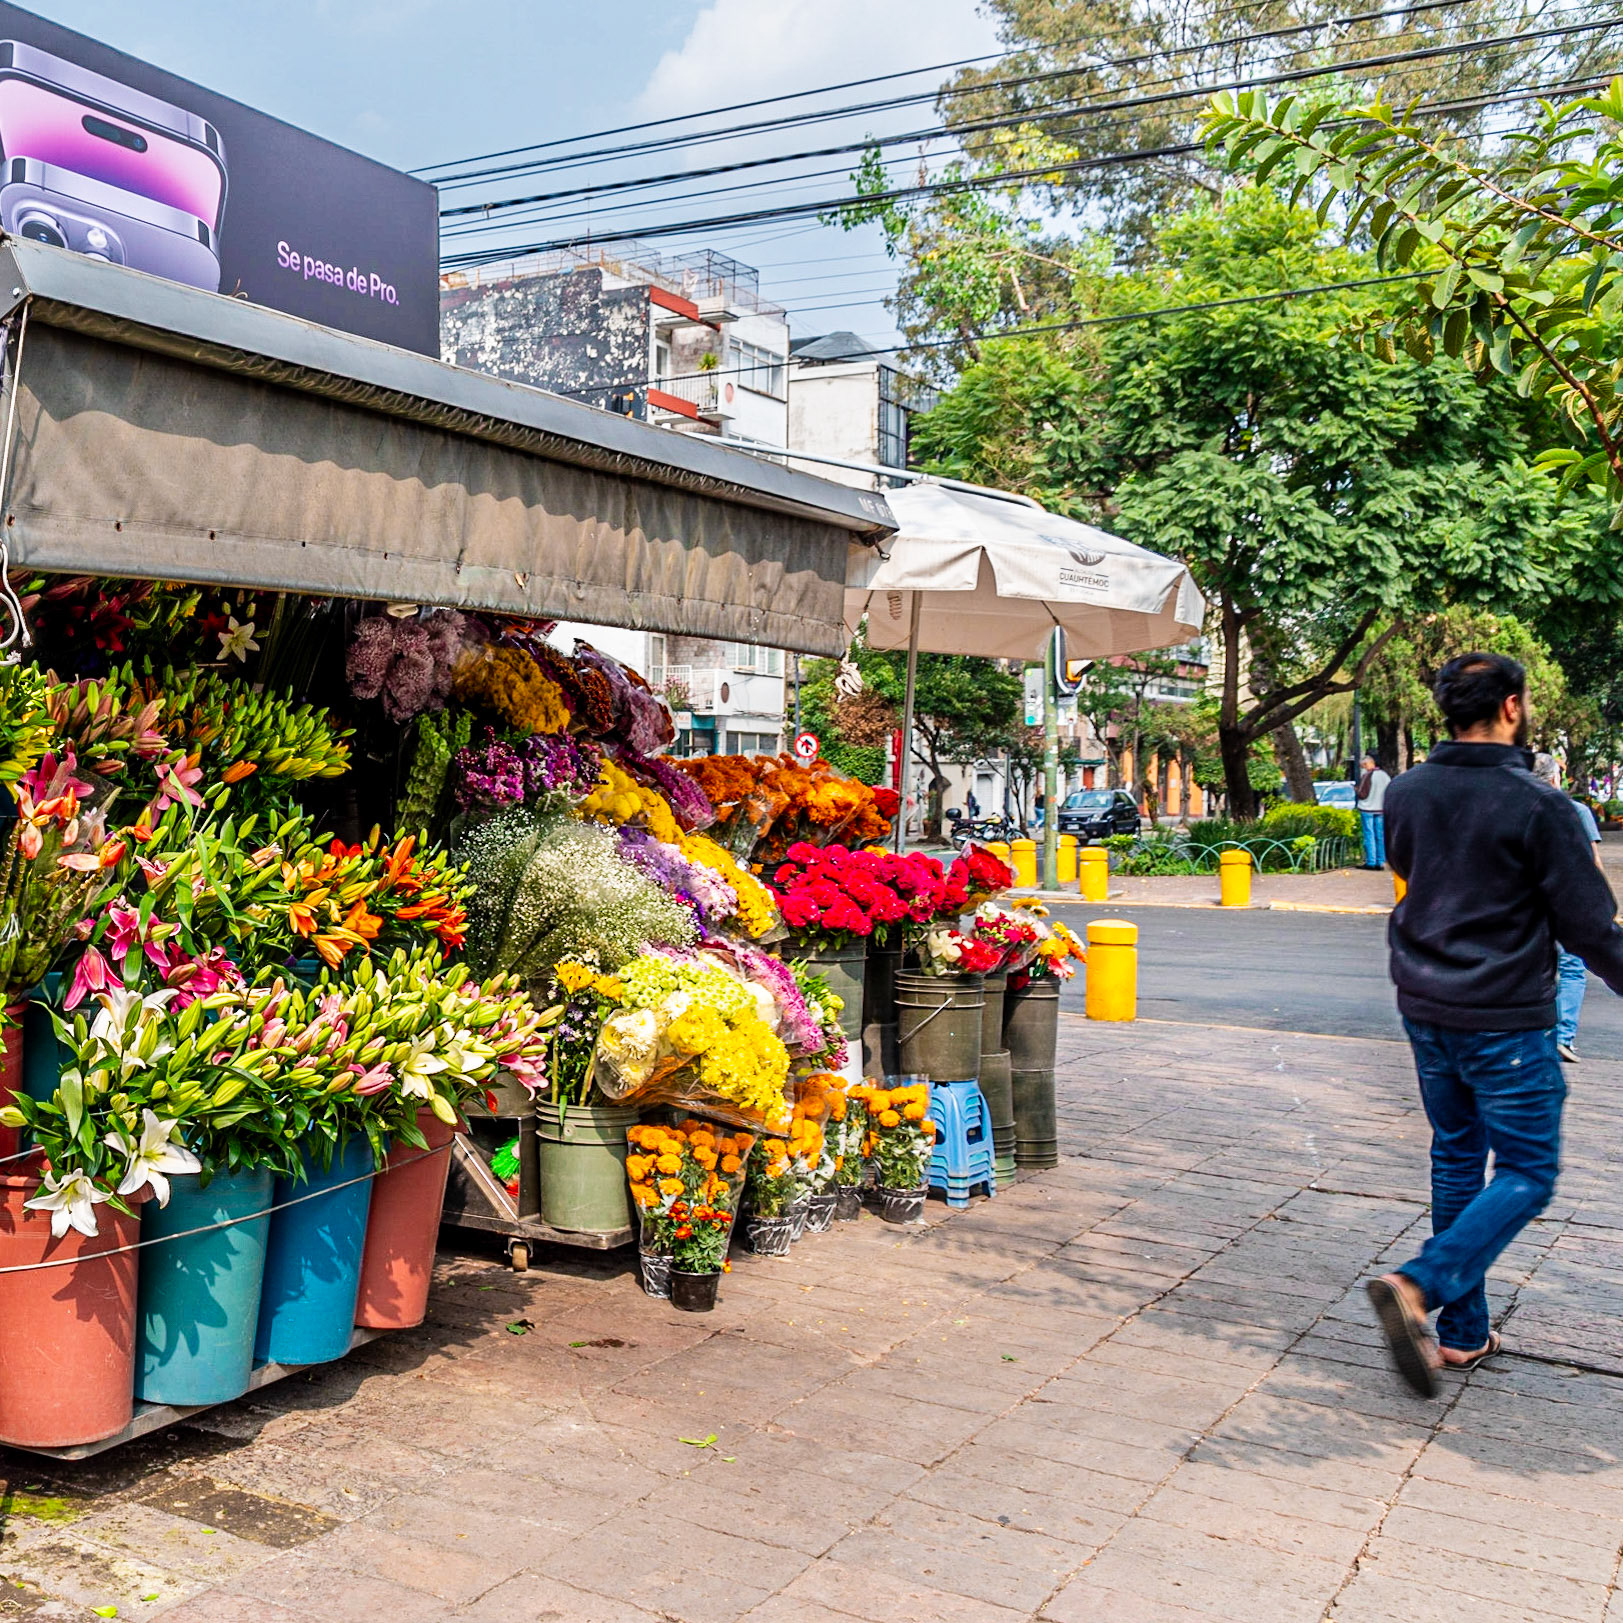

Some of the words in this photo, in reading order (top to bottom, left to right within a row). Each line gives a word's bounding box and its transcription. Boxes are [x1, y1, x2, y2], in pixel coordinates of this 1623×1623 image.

[277, 240, 301, 272] Se
[304, 255, 344, 288] pasa
[346, 266, 368, 295] de
[369, 272, 400, 306] Pro.
